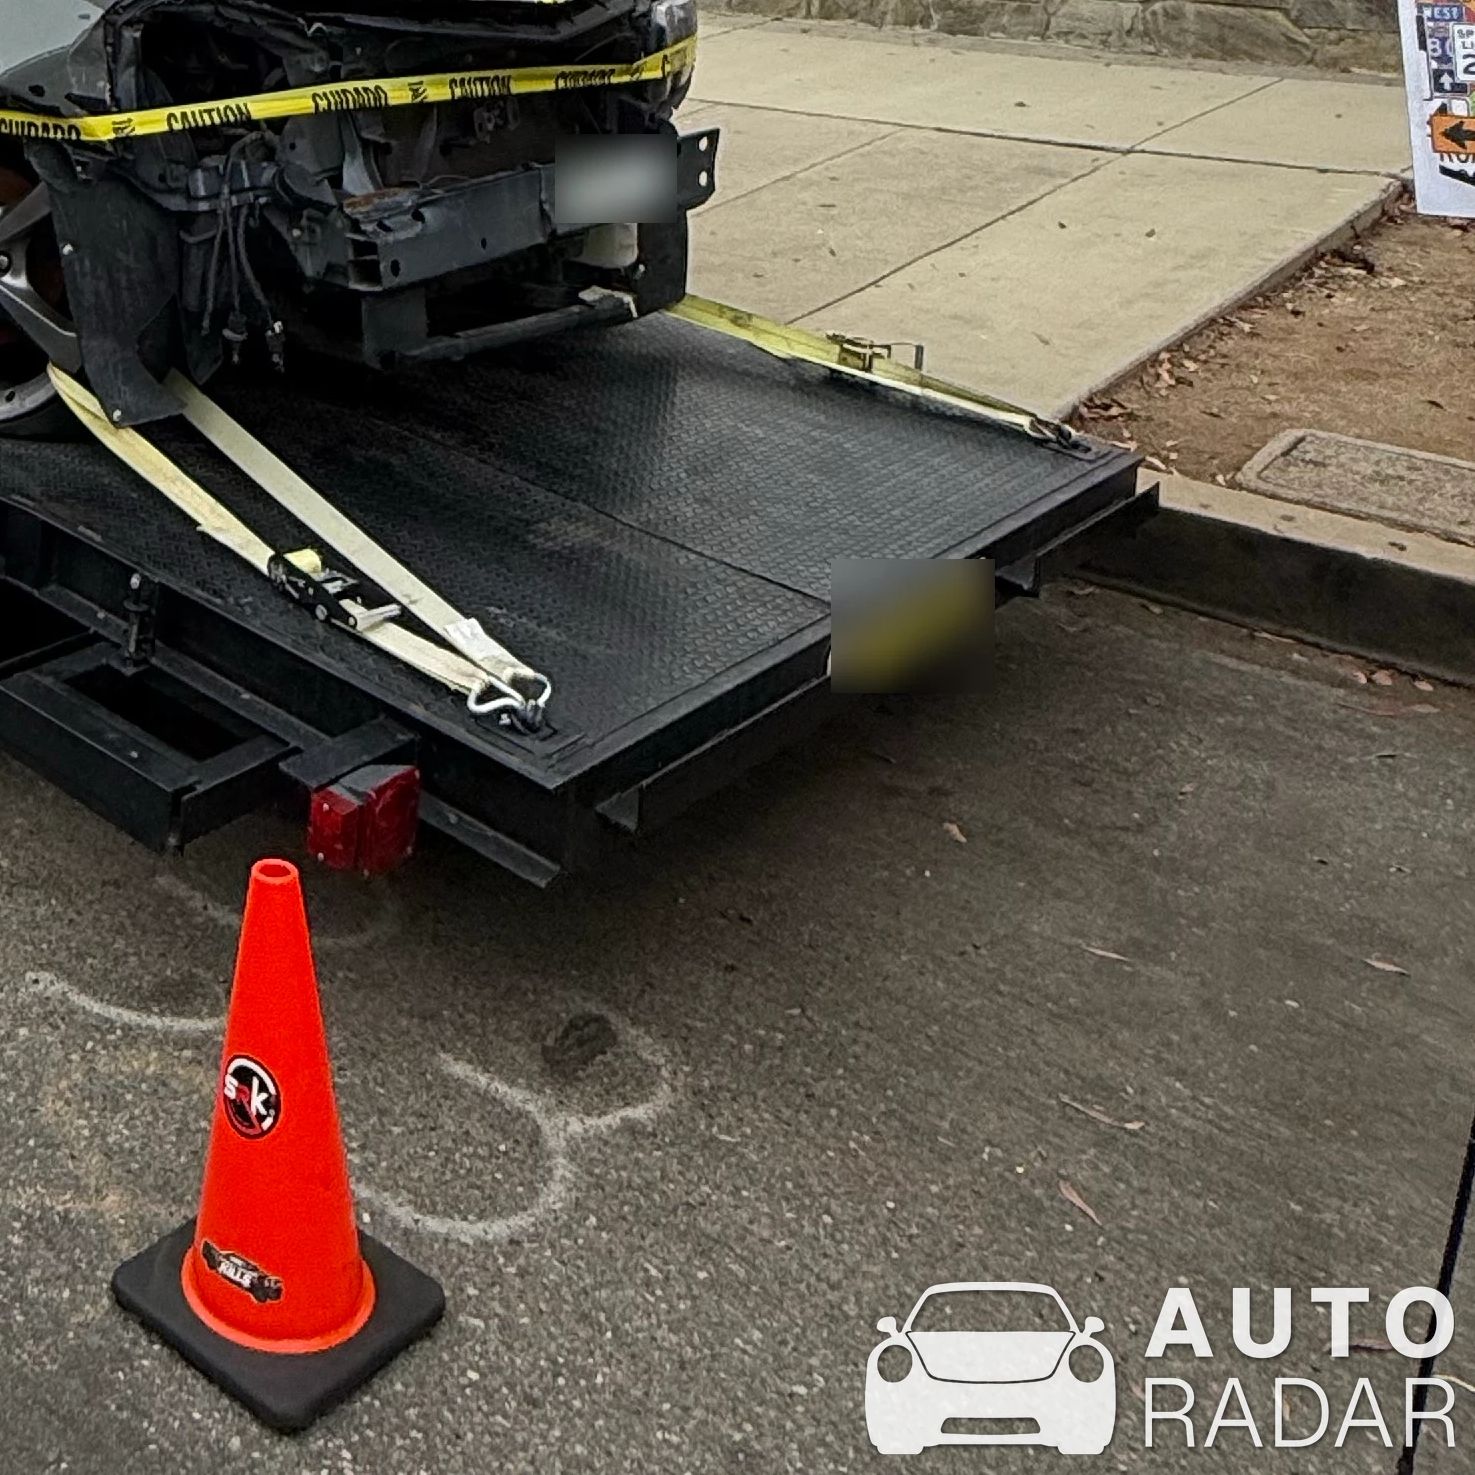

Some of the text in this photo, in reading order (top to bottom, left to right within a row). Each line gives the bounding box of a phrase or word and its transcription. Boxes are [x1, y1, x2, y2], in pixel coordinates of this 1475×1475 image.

[166, 102, 251, 131] CAUTION
[311, 84, 389, 114] CUIDADO
[448, 74, 514, 100] CAUTION
